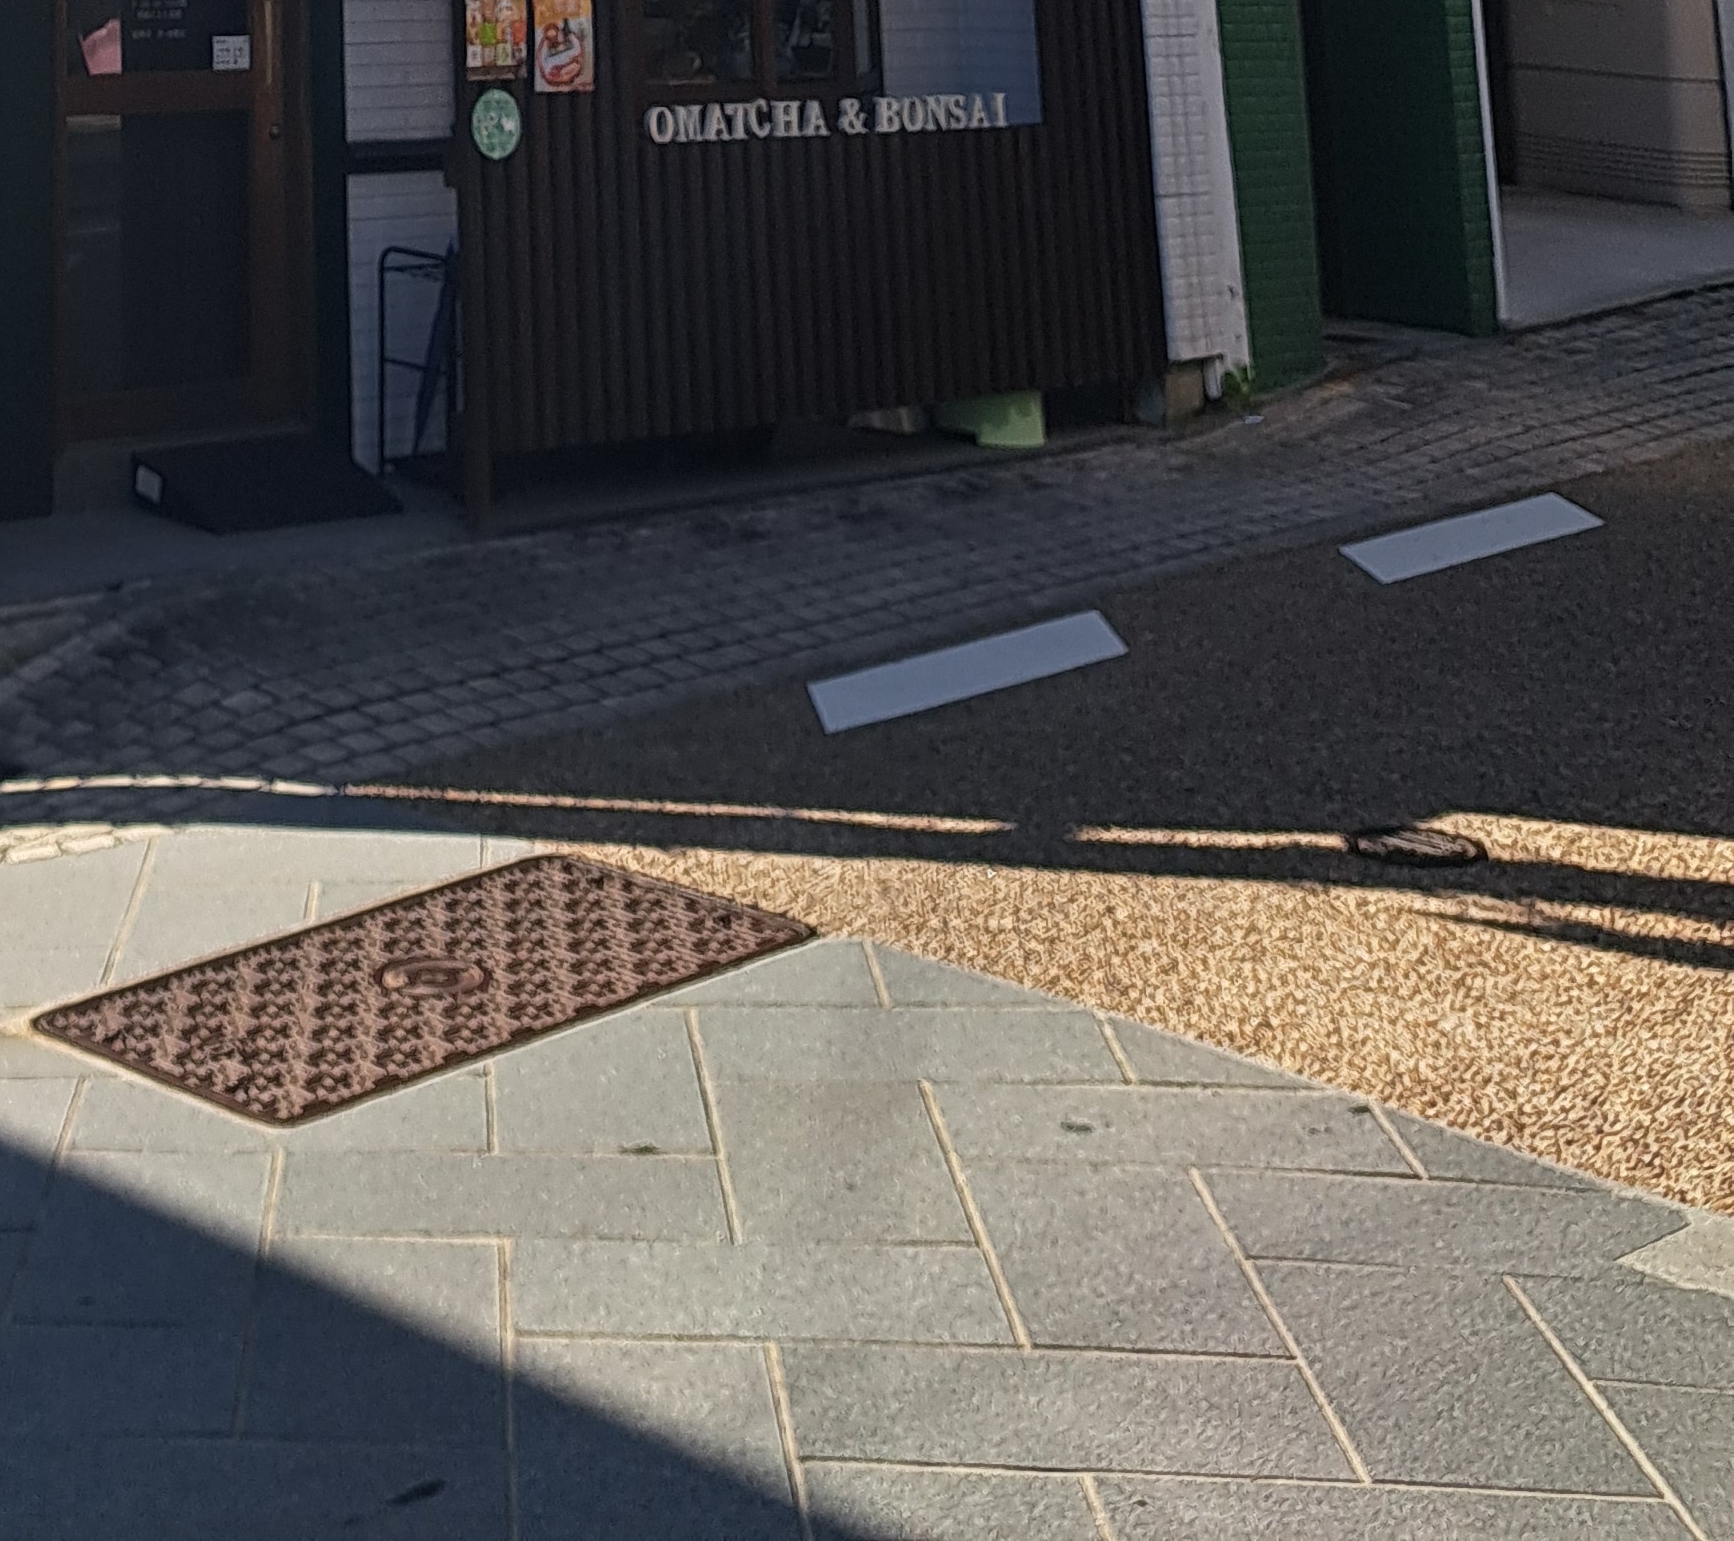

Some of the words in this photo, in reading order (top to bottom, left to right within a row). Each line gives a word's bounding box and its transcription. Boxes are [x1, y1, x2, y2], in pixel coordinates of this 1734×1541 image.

[646, 97, 831, 145] OMATCHA
[838, 96, 869, 136] &
[873, 91, 1008, 135] BONSAI
